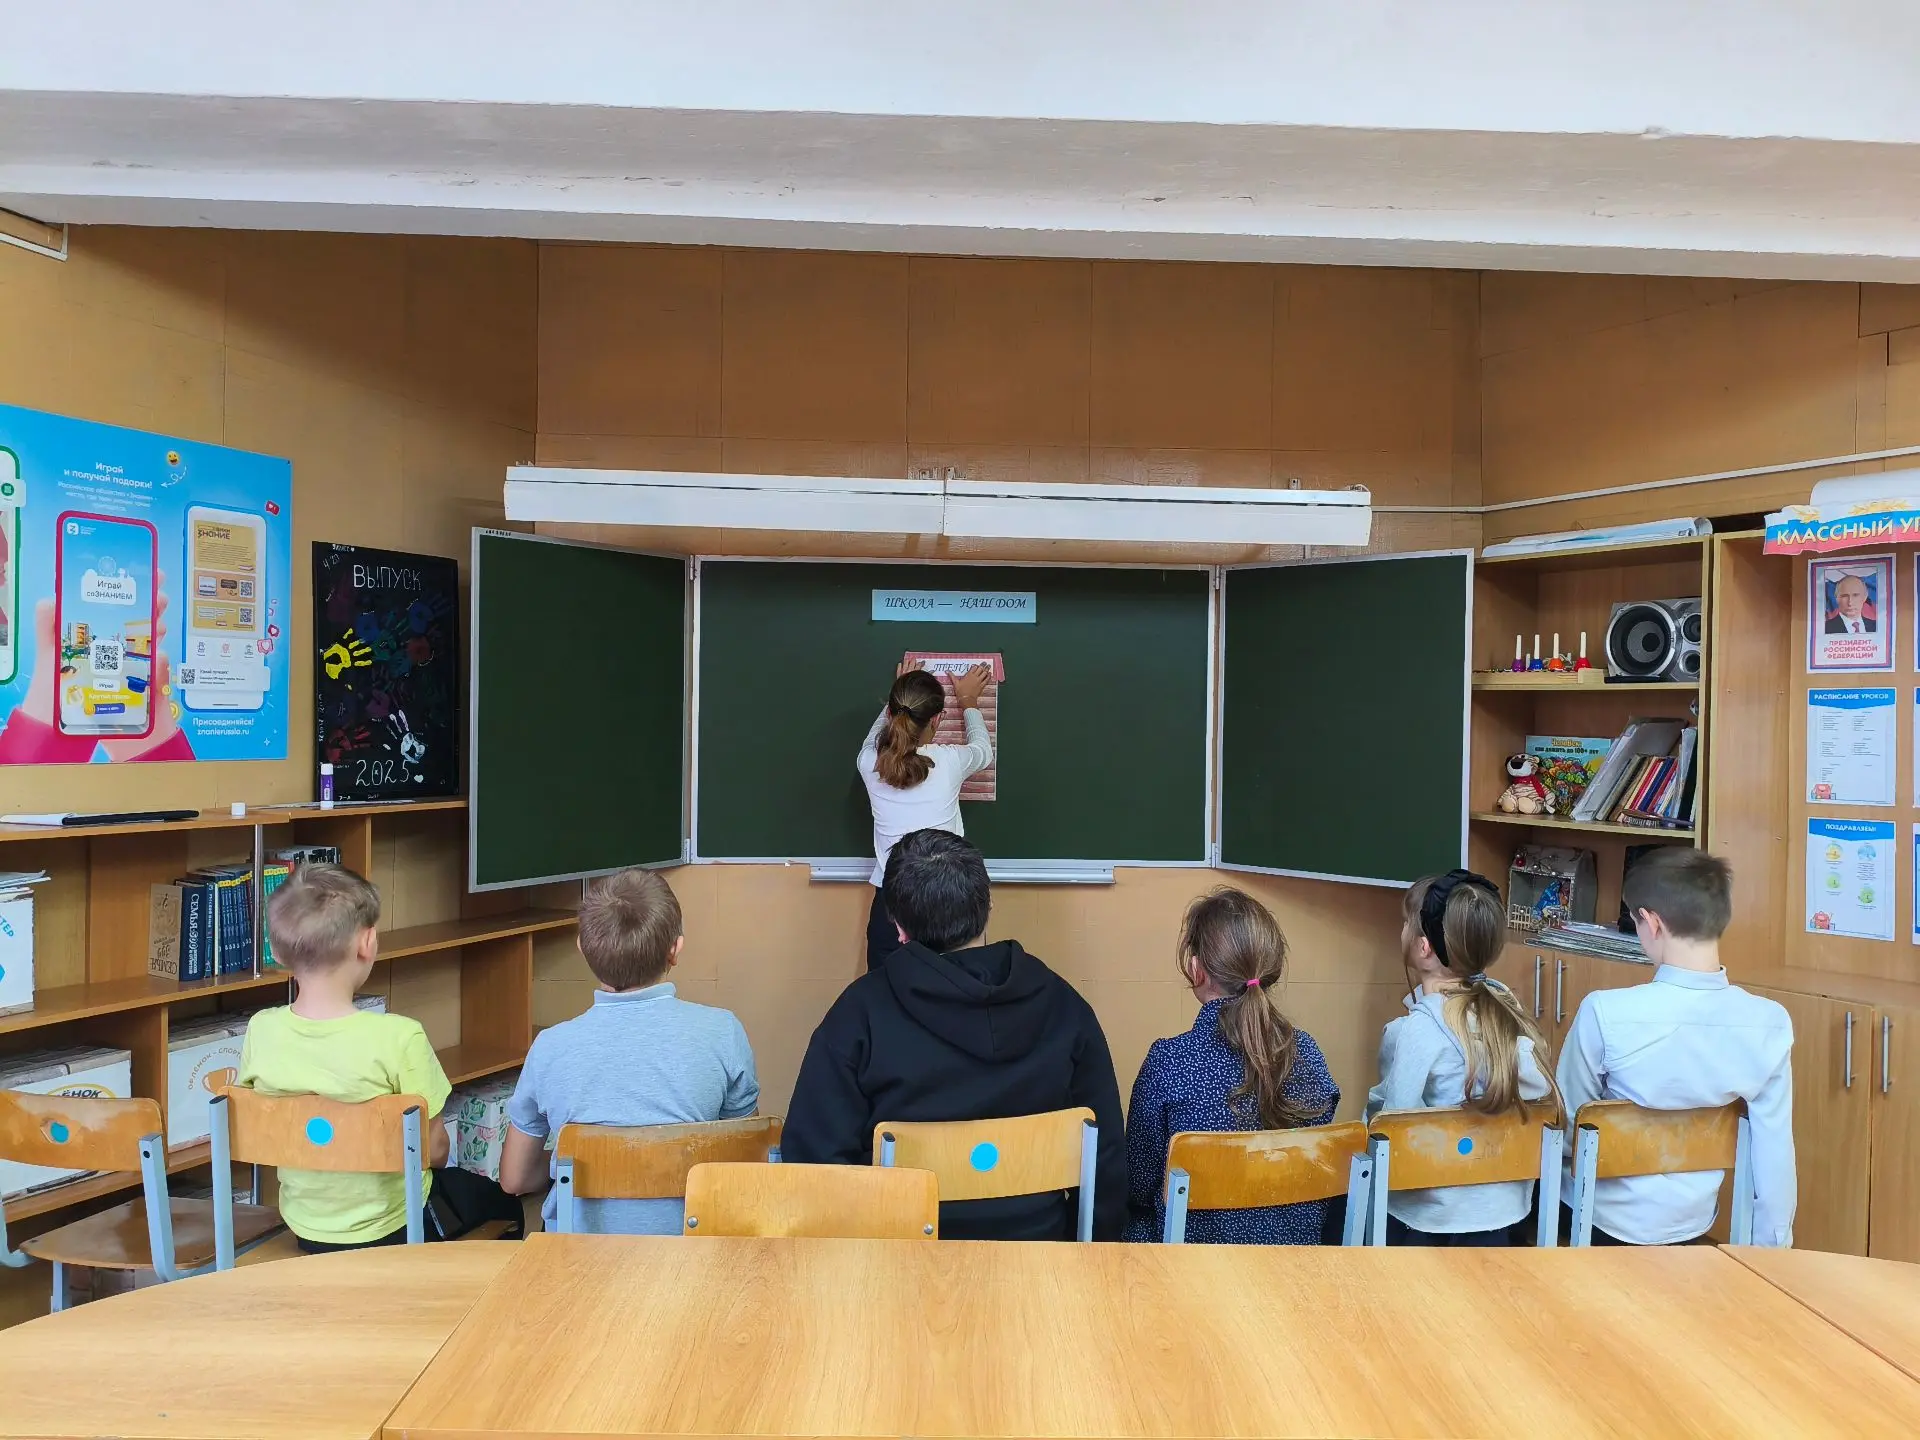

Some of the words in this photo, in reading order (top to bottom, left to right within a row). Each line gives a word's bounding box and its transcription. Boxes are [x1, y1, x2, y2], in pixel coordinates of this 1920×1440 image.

[95, 462, 124, 474] Играй
[72, 470, 111, 482] получай
[112, 477, 153, 489] подарки!
[1776, 515, 1894, 546] КЛАССНЫЙ
[353, 564, 422, 591] ВЫПУСК
[97, 579, 122, 590] Играй
[86, 590, 133, 600] соЗНАНИЕМ
[884, 597, 935, 609] ШКОЛА
[959, 597, 994, 609] НАШ
[995, 597, 1027, 609] ДОМ
[1823, 645, 1878, 653] РОССИЙСКОЙ
[192, 717, 255, 727] Присоединяйся!
[197, 728, 250, 736] znanierussia.ru
[355, 759, 410, 787] 2025
[0, 915, 14, 937] ТЕР
[62, 1089, 102, 1098] ЁНОК
